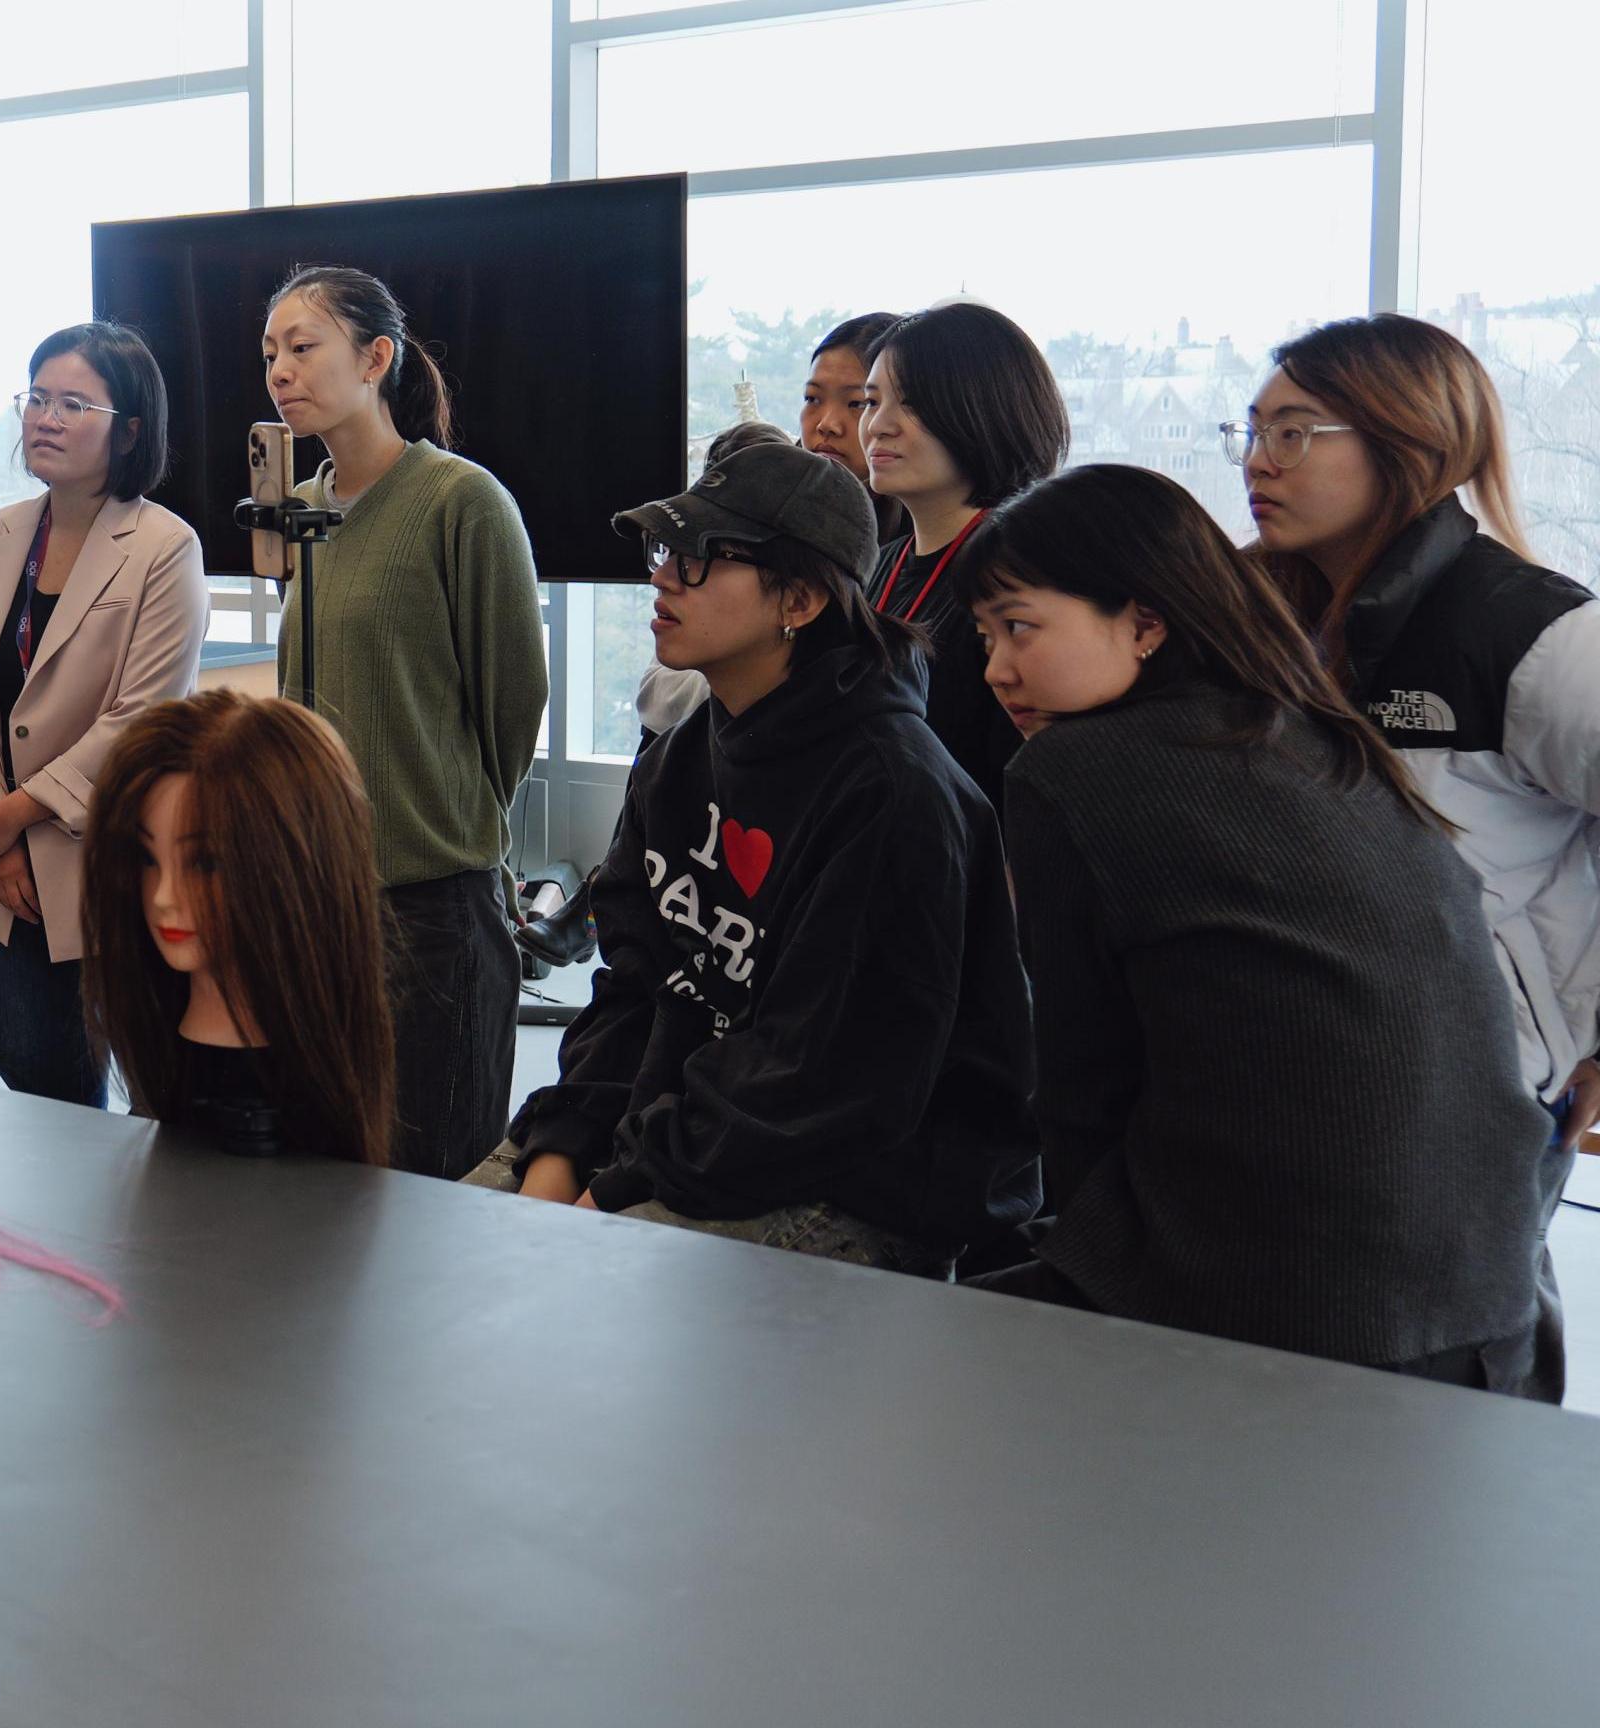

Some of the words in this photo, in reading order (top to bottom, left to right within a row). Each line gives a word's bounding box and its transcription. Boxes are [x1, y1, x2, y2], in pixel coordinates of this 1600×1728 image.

[1390, 689, 1423, 704] THE
[1367, 702, 1425, 717] NORTH
[1382, 715, 1425, 729] FACE
[689, 802, 721, 870] I
